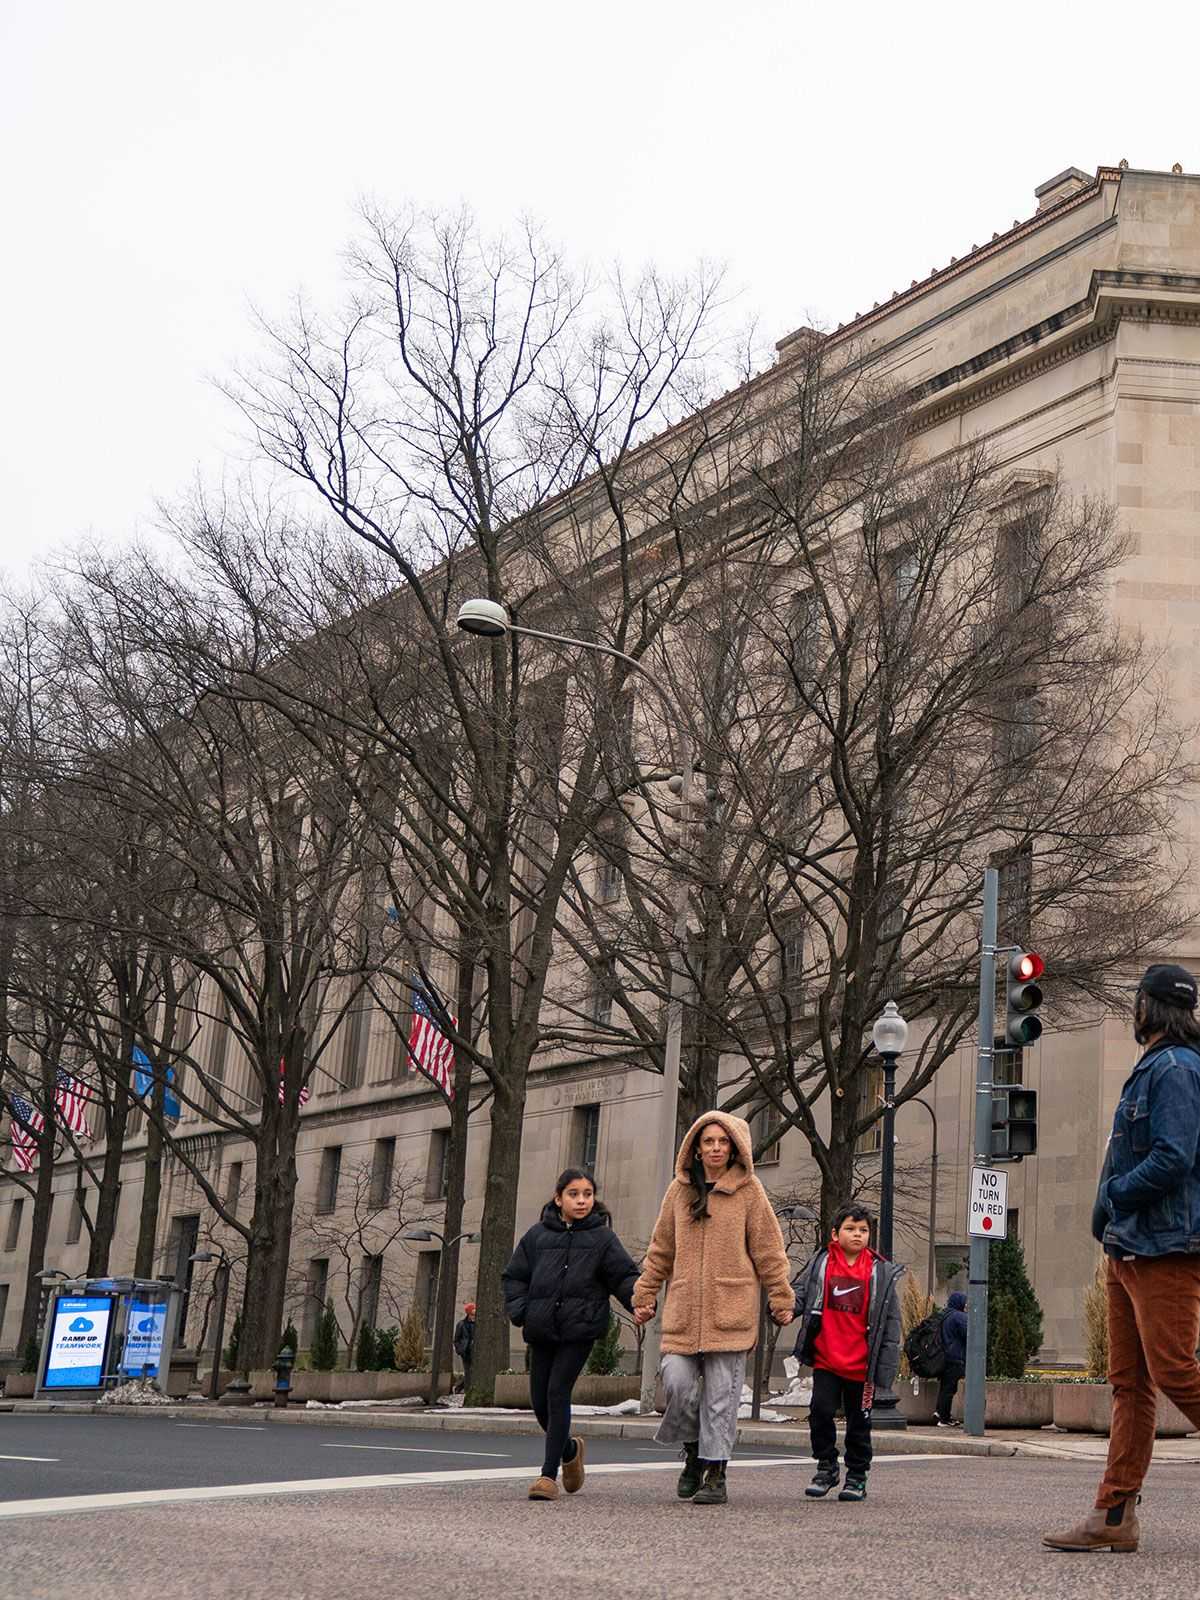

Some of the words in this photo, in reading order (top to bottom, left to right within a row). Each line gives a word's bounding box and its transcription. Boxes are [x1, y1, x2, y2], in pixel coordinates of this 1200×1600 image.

[981, 1173, 998, 1187] NO
[978, 1188, 1000, 1201] TURN
[972, 1202, 984, 1214] ON
[987, 1204, 1004, 1216] RED
